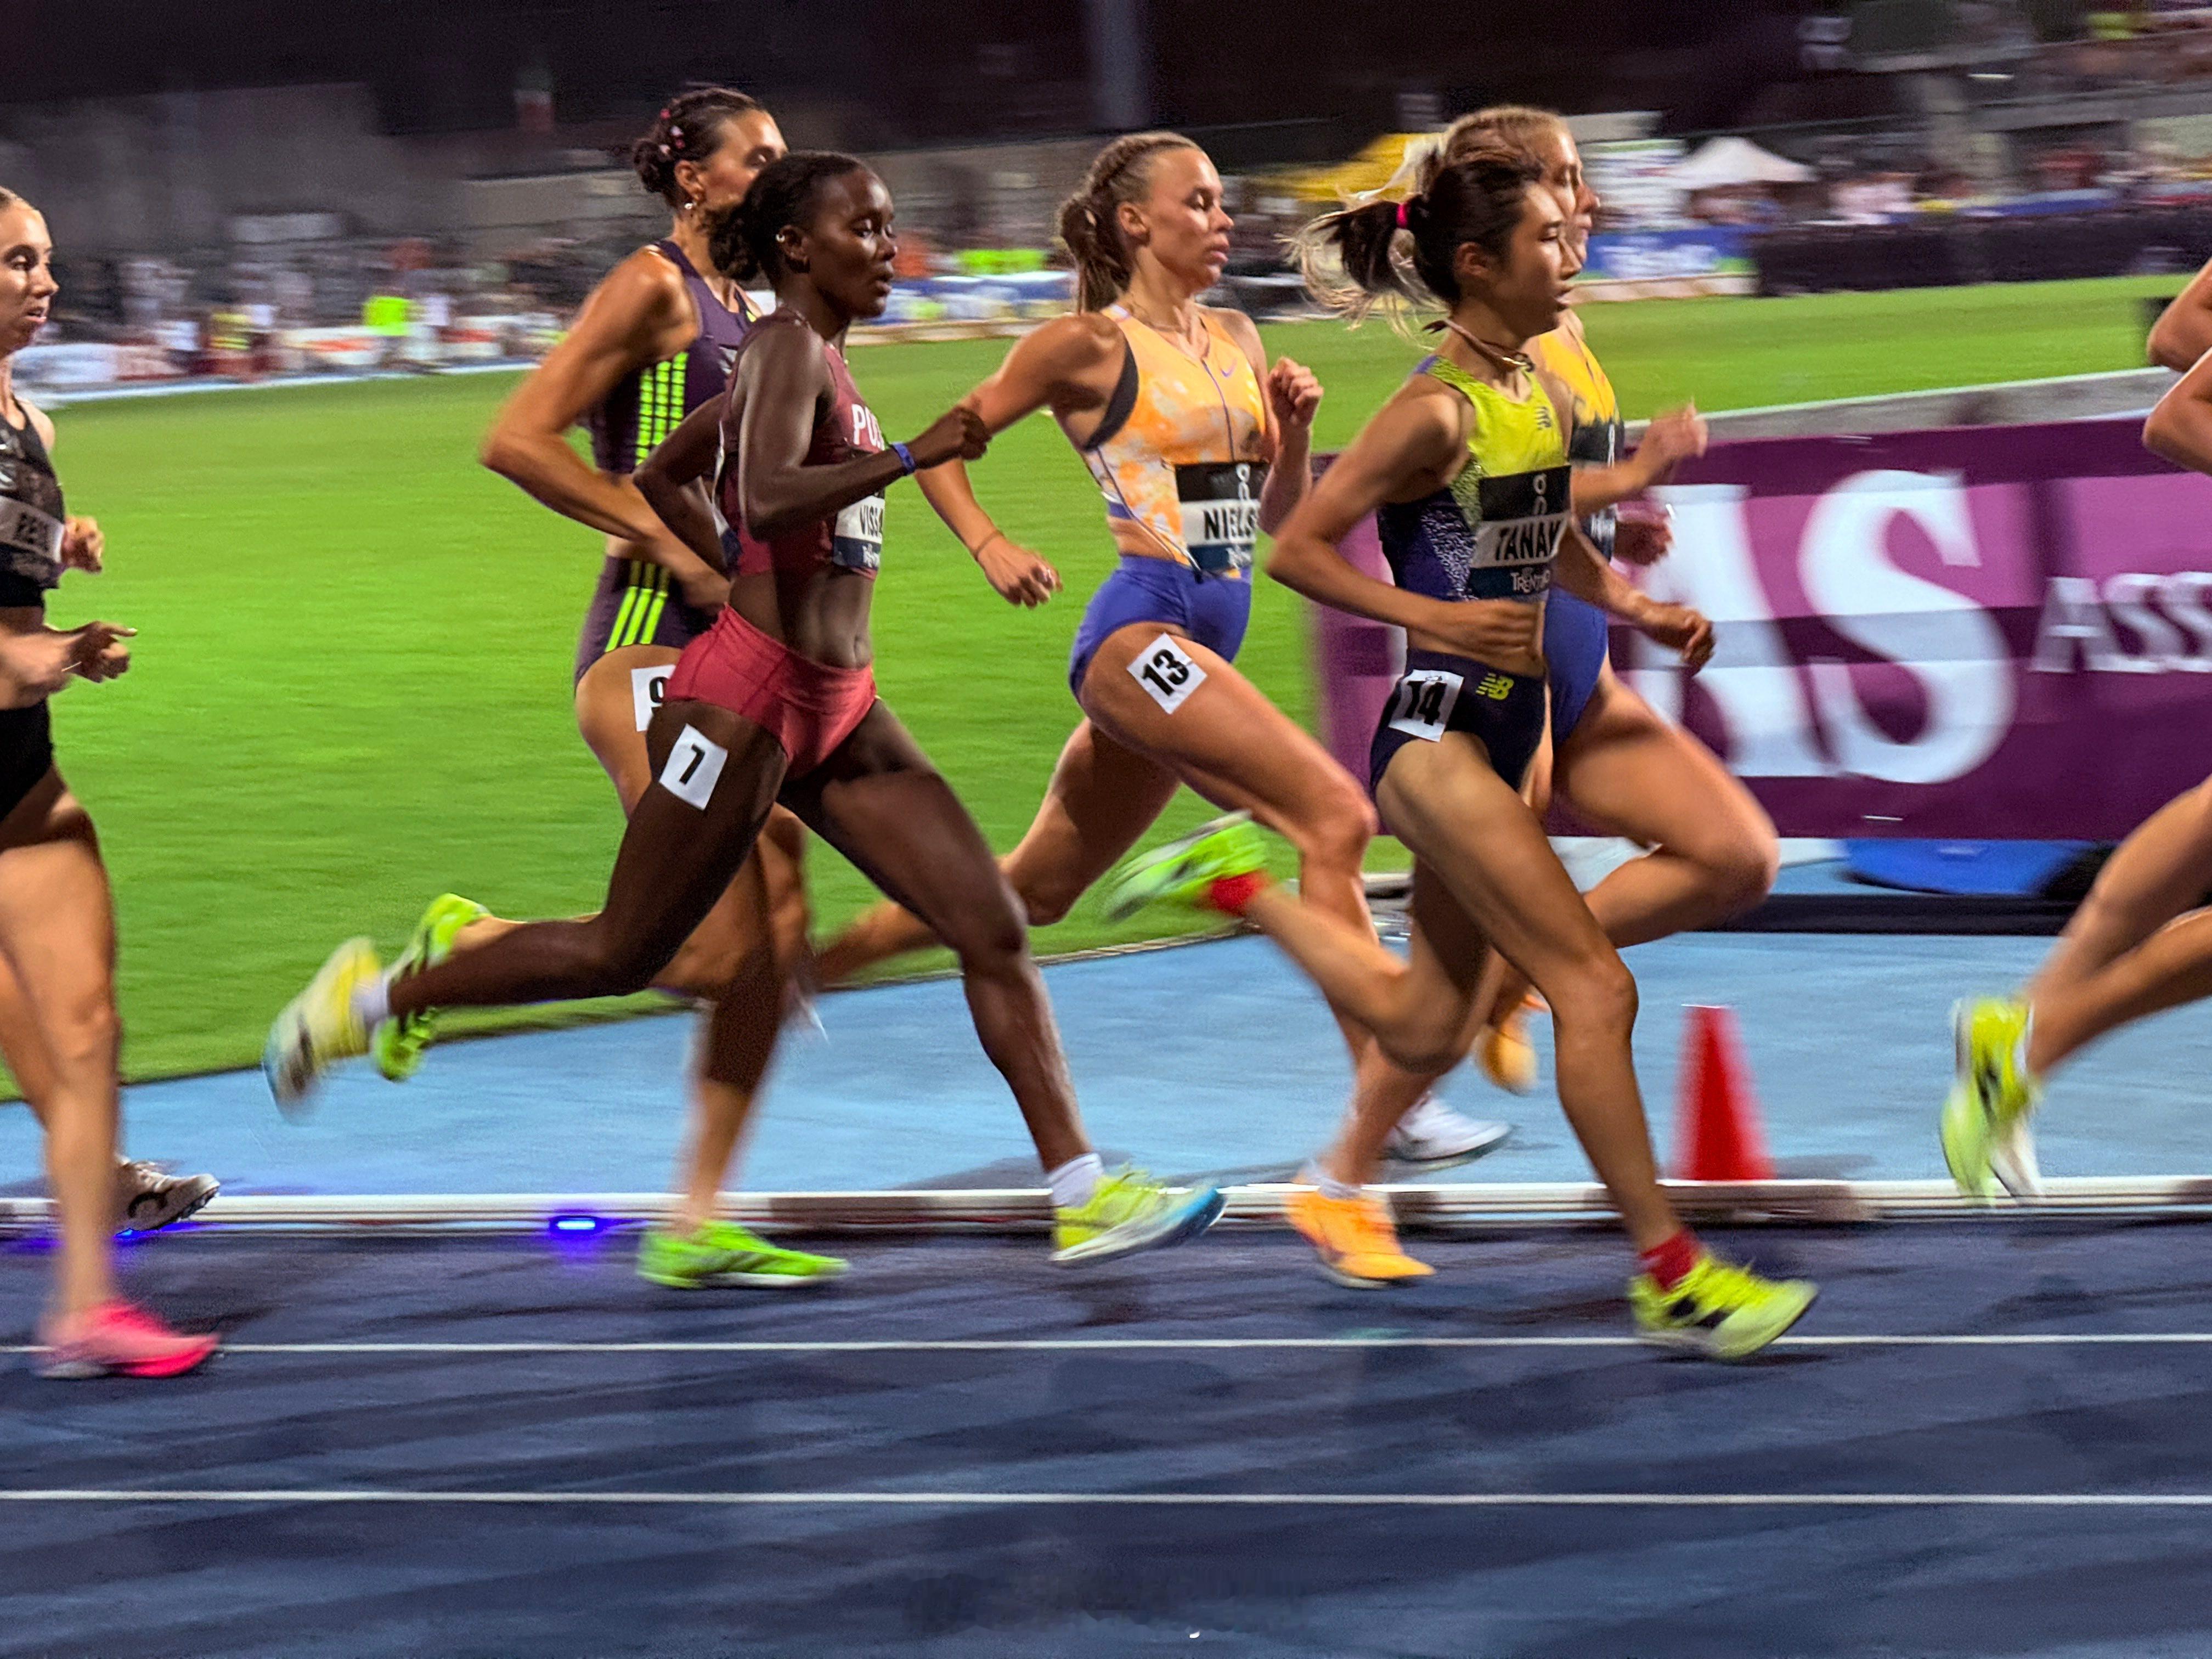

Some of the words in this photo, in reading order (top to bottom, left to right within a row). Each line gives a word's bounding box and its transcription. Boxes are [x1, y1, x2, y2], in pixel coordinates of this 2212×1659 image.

[1142, 649, 1189, 697] 13
[1404, 680, 1447, 726] 14
[679, 743, 706, 785] 7
